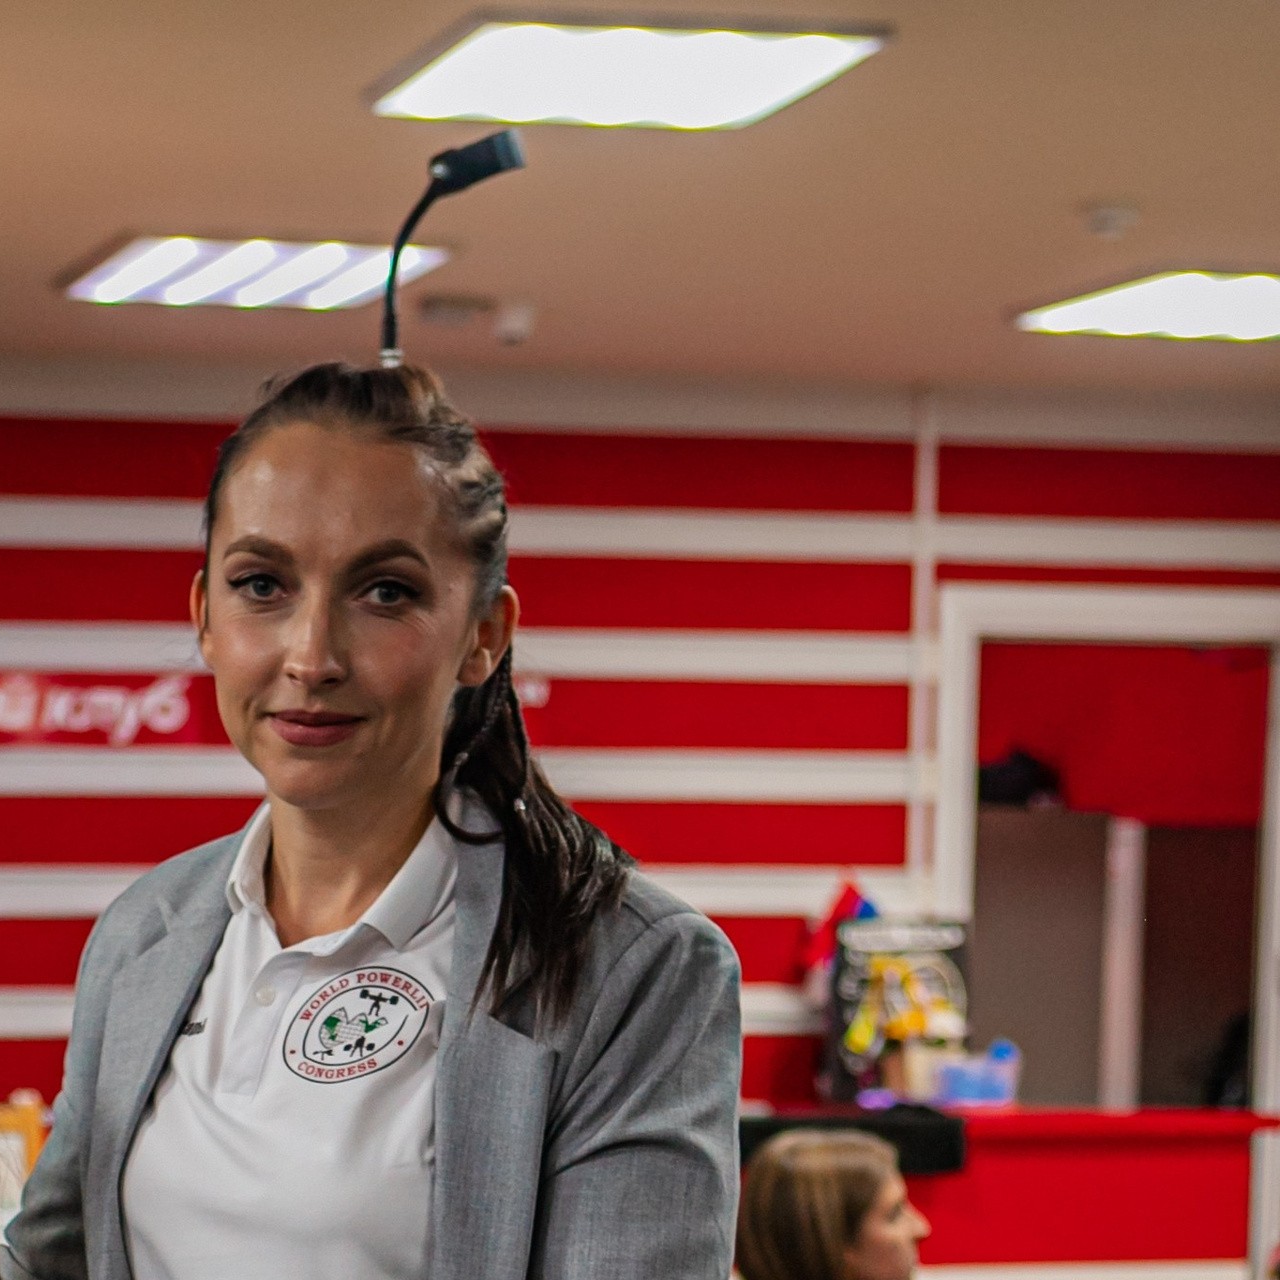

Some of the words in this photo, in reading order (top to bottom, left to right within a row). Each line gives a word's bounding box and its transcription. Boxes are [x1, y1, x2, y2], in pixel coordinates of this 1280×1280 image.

[44, 675, 189, 745] клуб
[299, 977, 350, 1022] WORLD
[297, 1058, 378, 1080] CONGRESS
